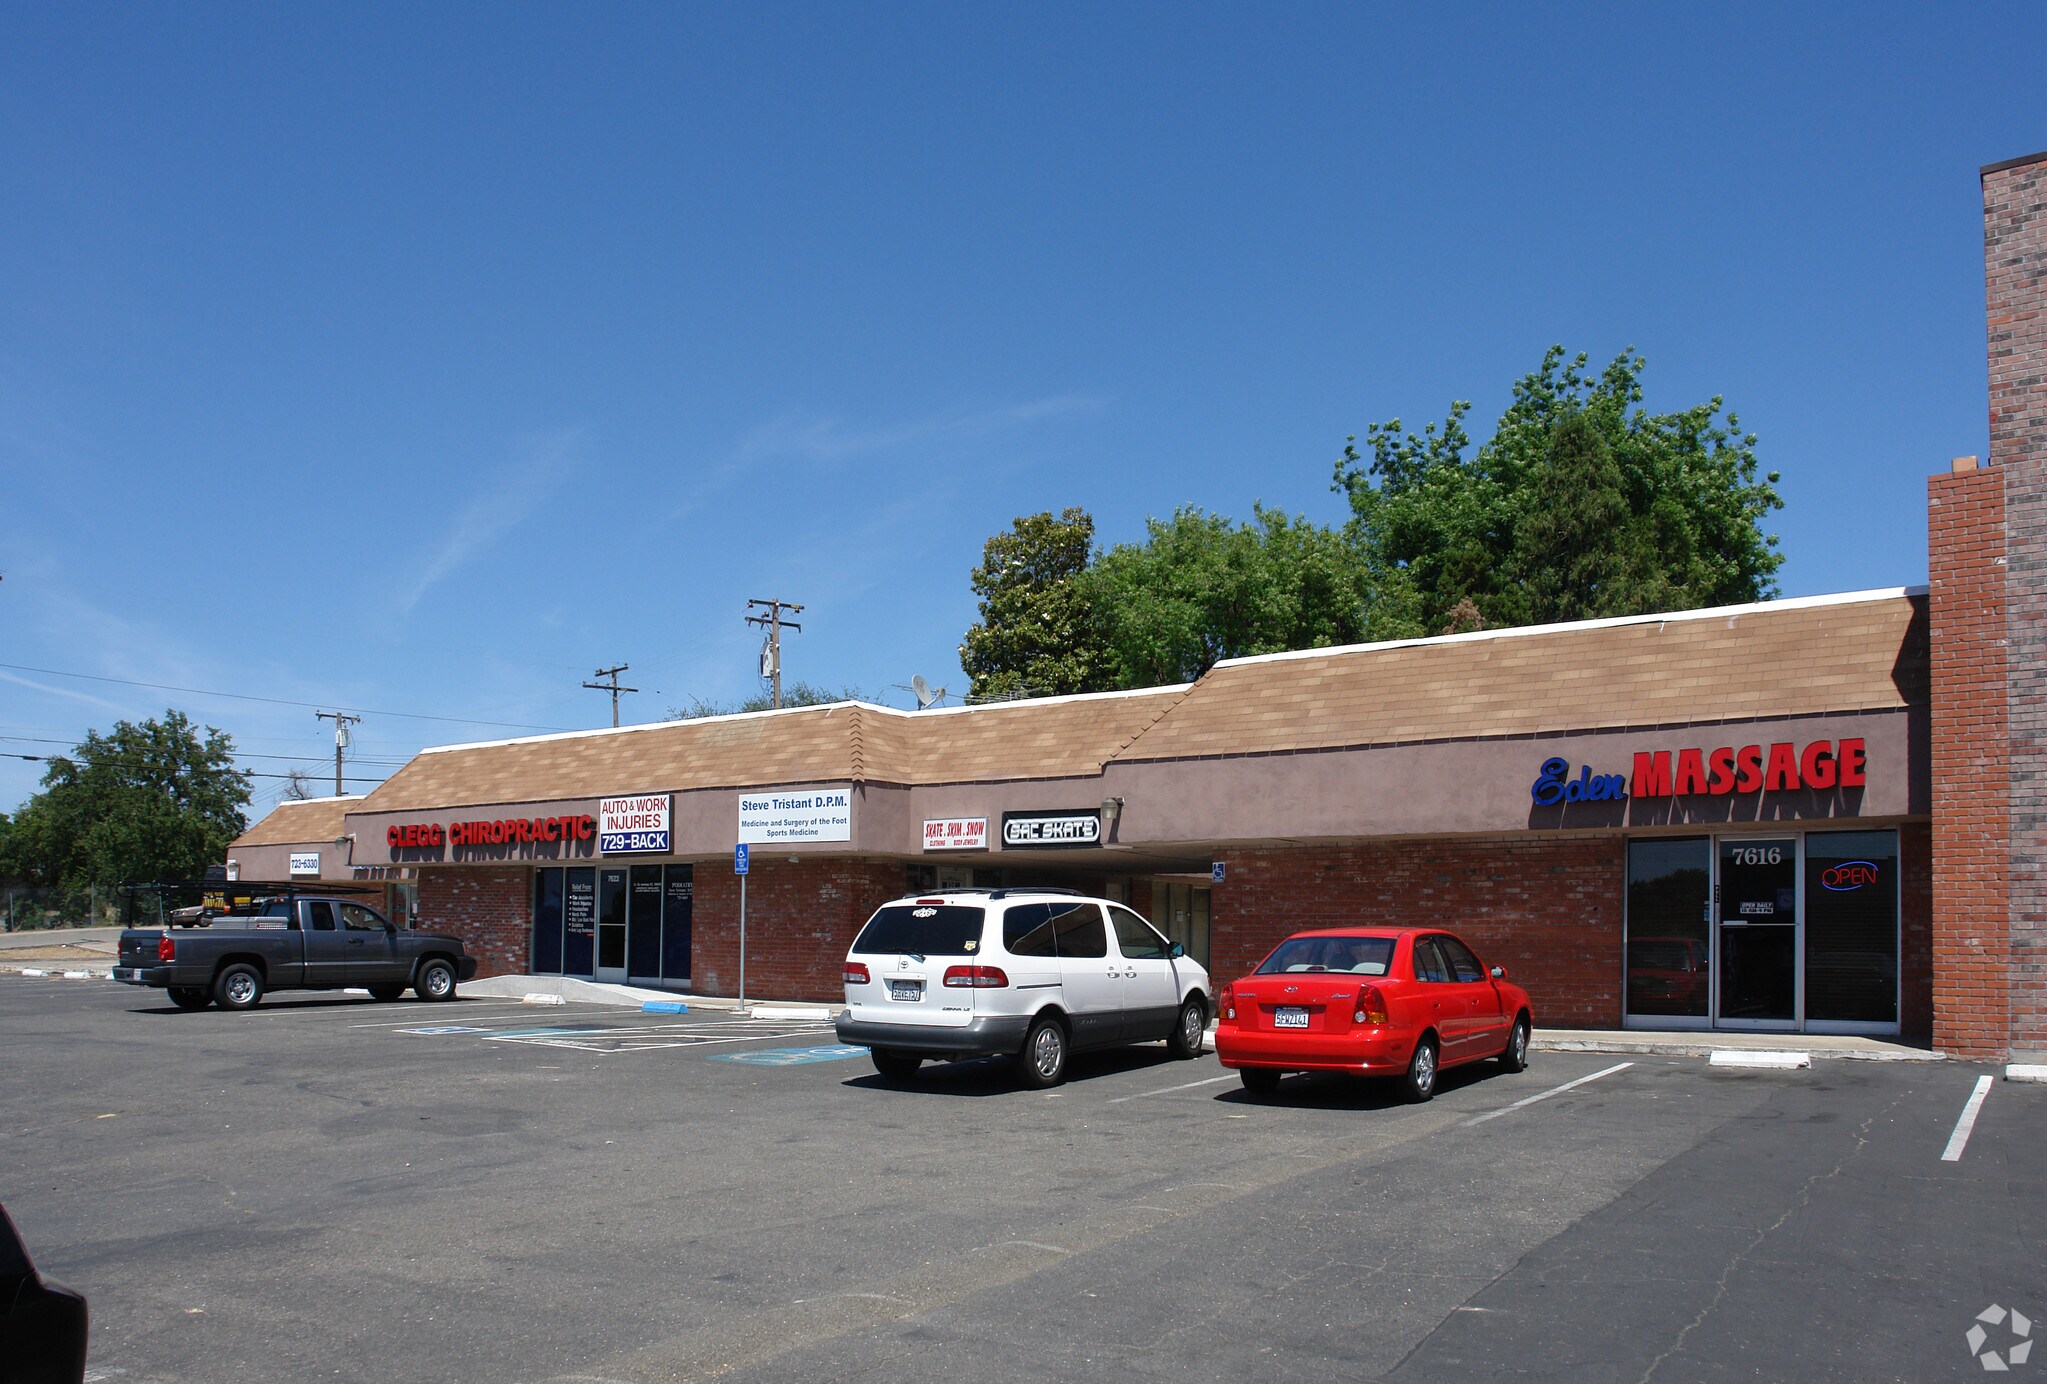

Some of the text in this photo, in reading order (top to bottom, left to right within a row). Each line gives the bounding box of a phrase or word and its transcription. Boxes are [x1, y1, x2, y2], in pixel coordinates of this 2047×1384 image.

[1531, 737, 1866, 806] Eden MASSAGE
[602, 797, 667, 815] AUTO & WORK
[741, 796, 847, 811] Steve Tristant D.P.M.
[387, 814, 593, 848] CLEGG CHIROPRACTIC
[607, 814, 661, 831] INJURIES
[741, 820, 769, 828] Medicine
[770, 819, 782, 827] and
[783, 818, 809, 828] Surgery
[819, 817, 830, 825] the
[832, 817, 847, 825] Foot
[925, 821, 985, 838] SKATE SKIM SNOW
[1010, 820, 1094, 840] SAC SKATE
[602, 832, 665, 850] 729-BACK
[766, 828, 818, 838] Sports Medicine
[929, 839, 946, 847] CLOTHING
[291, 859, 318, 869] 723-6330
[1732, 847, 1781, 866] 7616
[1822, 867, 1877, 886] OPEN
